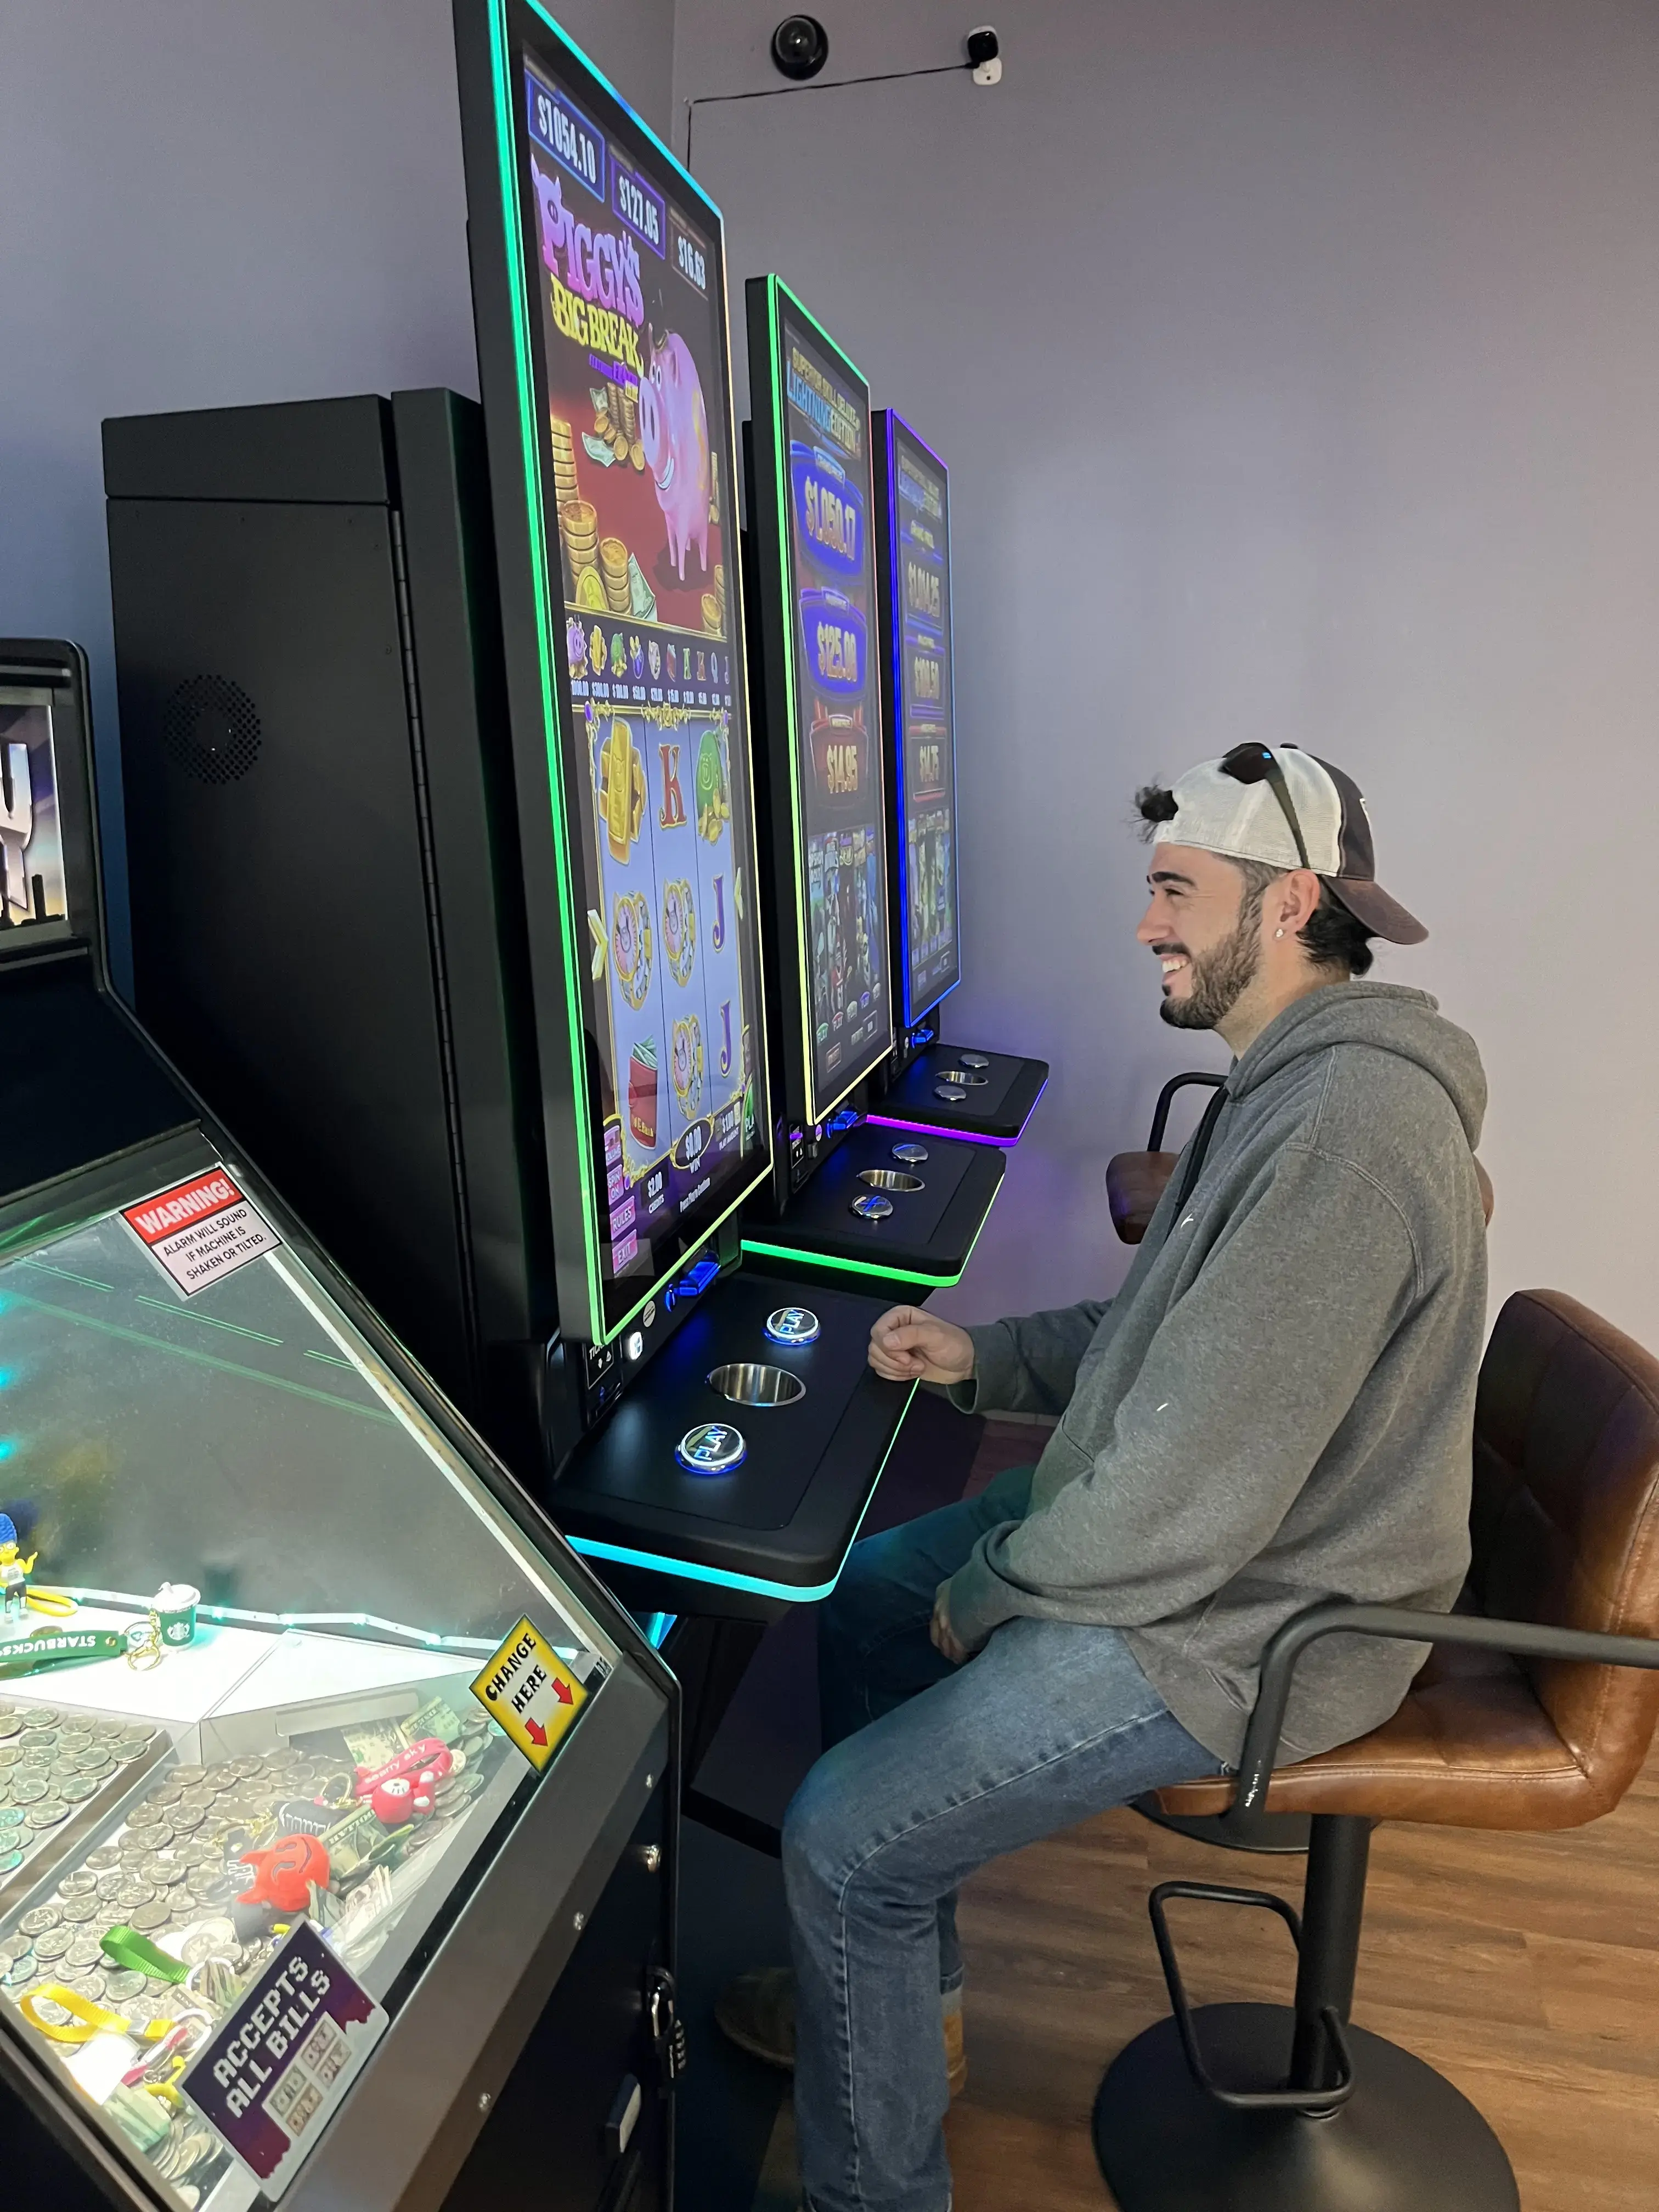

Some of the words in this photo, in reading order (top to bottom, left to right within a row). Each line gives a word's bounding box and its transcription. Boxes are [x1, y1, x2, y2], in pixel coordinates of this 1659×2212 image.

[537, 95, 597, 184] $1054.10
[619, 175, 659, 245] $127.05
[678, 235, 706, 290] $16.63
[550, 273, 589, 346] BIG
[587, 304, 644, 379] BREAK
[787, 360, 832, 433] LIGHTNING
[608, 1172, 620, 1188] SPIN
[611, 1187, 620, 1199] ON
[135, 1178, 235, 1234] WARNING!
[612, 1207, 631, 1231] RULES
[164, 1234, 198, 1256] ALARM
[194, 1224, 218, 1243] WILL
[218, 1209, 247, 1229] SOUND
[185, 1251, 197, 1262] IF
[198, 1231, 236, 1257] MACHINE
[235, 1226, 246, 1237] IS
[186, 1255, 224, 1279] SHAKEN
[223, 1247, 237, 1260] OR
[236, 1233, 267, 1253] TILTED.
[617, 1242, 631, 1263] EXIT
[779, 1309, 805, 1335] PLAY
[693, 1425, 728, 1461] PLAY
[485, 1633, 537, 1701] CHANGE
[511, 1664, 548, 1714] HERE
[213, 1956, 309, 2088] ACCEPTS
[225, 2059, 273, 2119] ALL
[266, 1970, 330, 2059] BILLS
